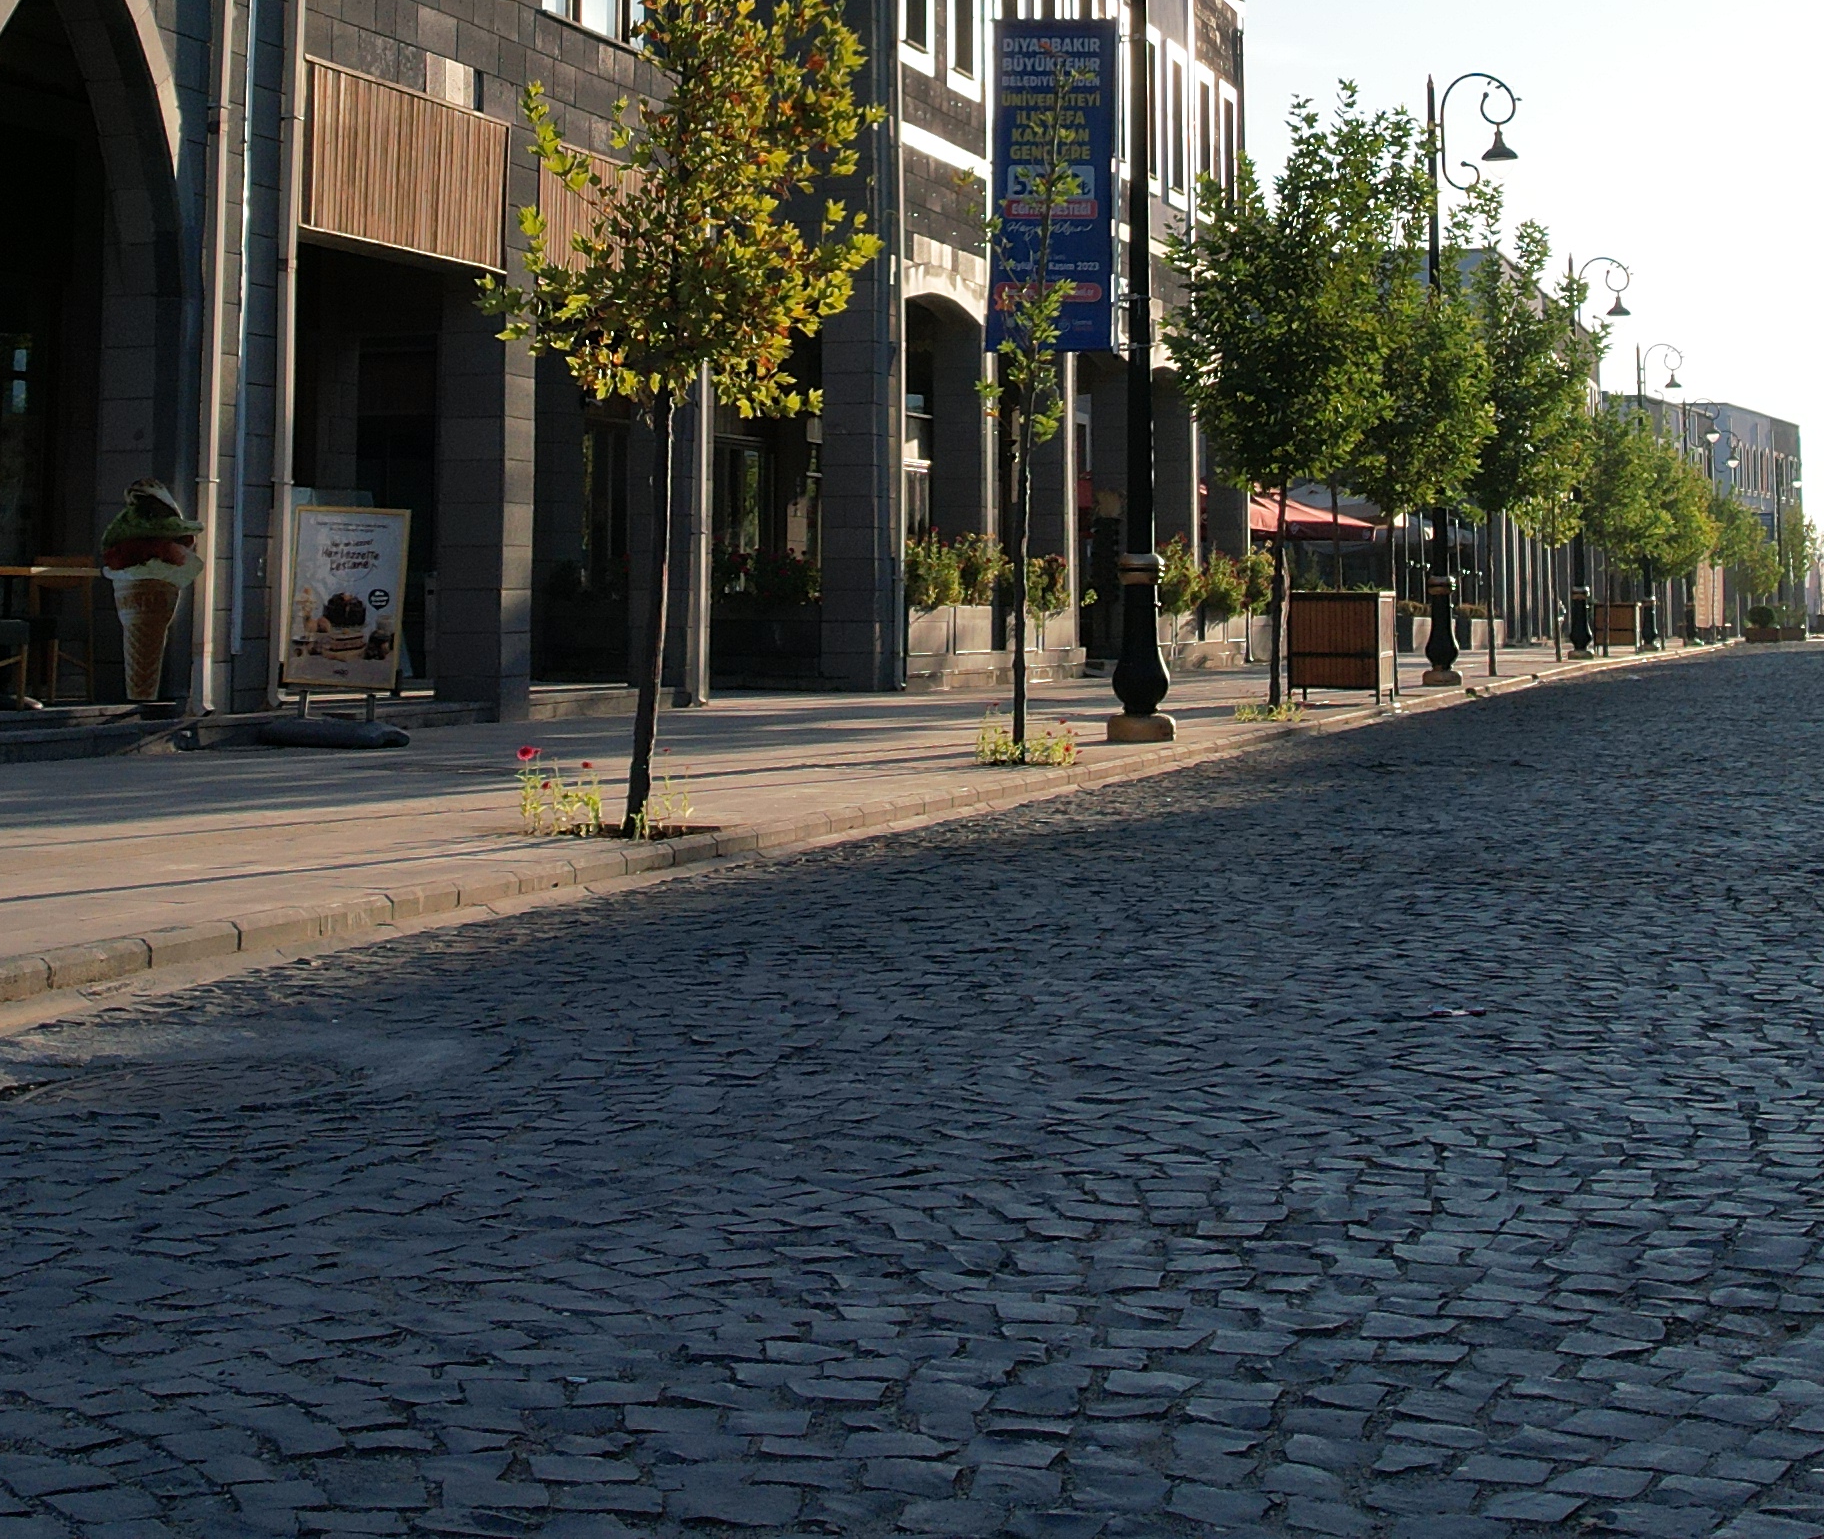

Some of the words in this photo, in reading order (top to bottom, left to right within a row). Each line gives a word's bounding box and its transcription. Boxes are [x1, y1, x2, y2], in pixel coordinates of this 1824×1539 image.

[1002, 91, 1101, 107] ÜNİVERTEYİ
[1045, 110, 1086, 125] EFA
[1011, 128, 1090, 142] KAZAN
